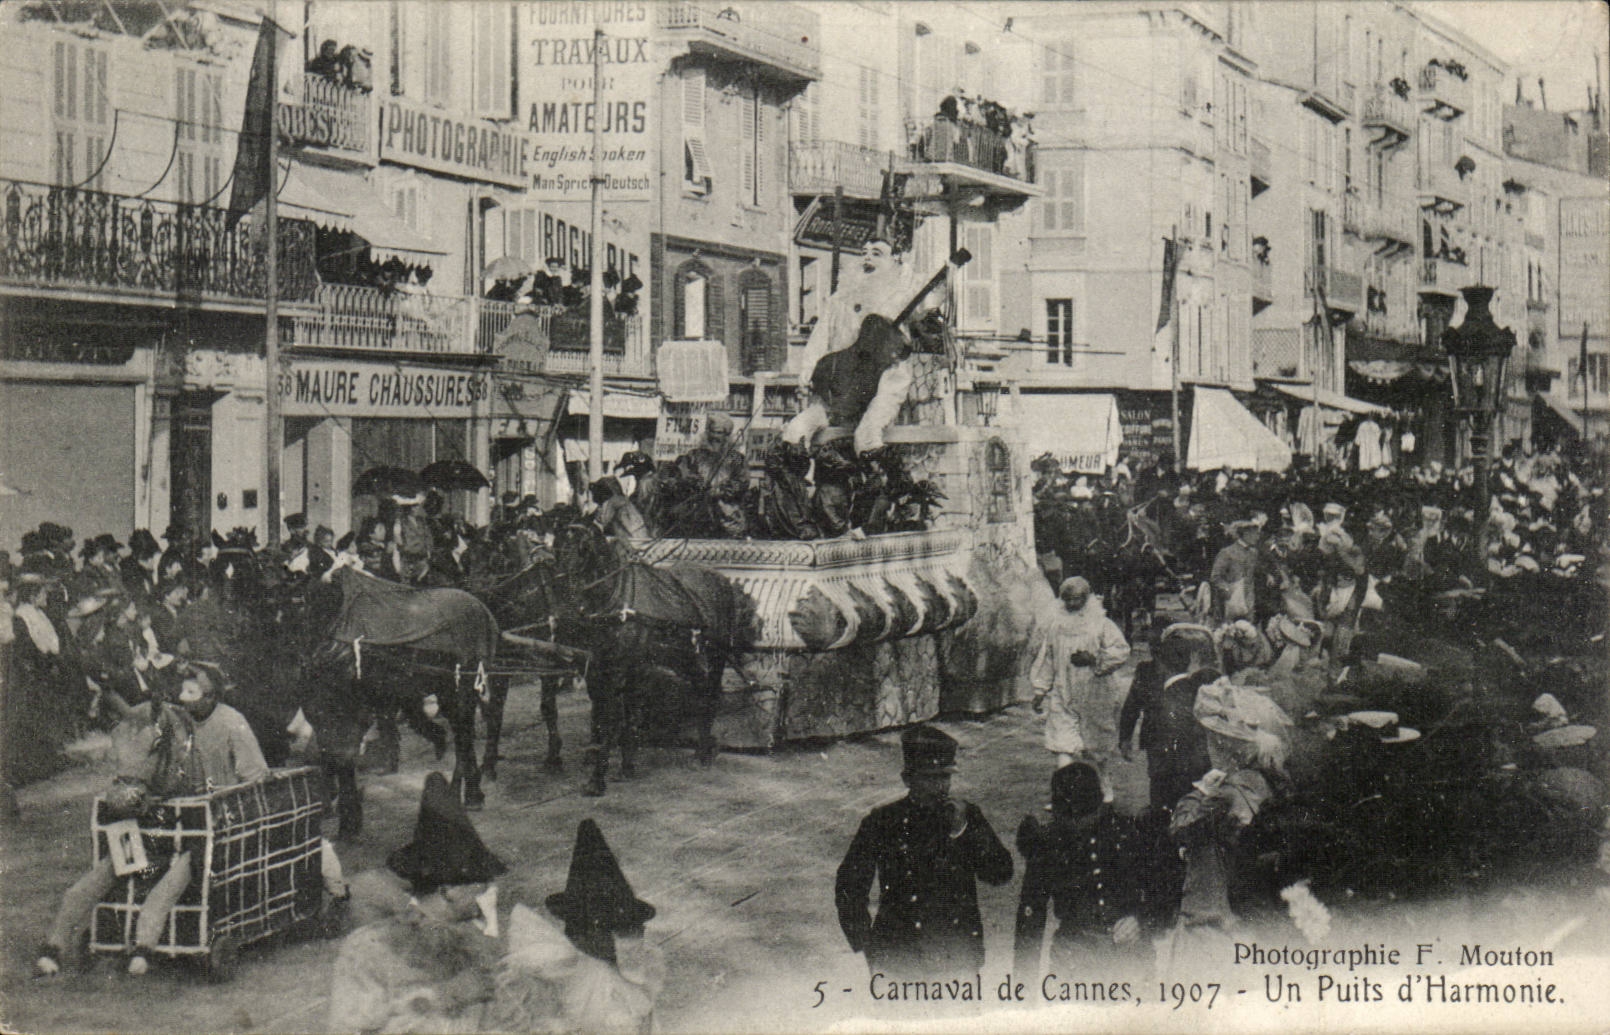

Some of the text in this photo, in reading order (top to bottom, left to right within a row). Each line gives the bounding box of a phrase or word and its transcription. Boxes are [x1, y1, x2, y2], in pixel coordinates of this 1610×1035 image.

[531, 37, 649, 66] TRAVAUX
[528, 102, 647, 134] AMATEURS
[385, 102, 530, 178] PHOTOGRAPHIE
[533, 146, 588, 168] English
[533, 174, 555, 190] Man
[296, 369, 360, 405] MAURE
[369, 373, 474, 407] CHAUSSURES
